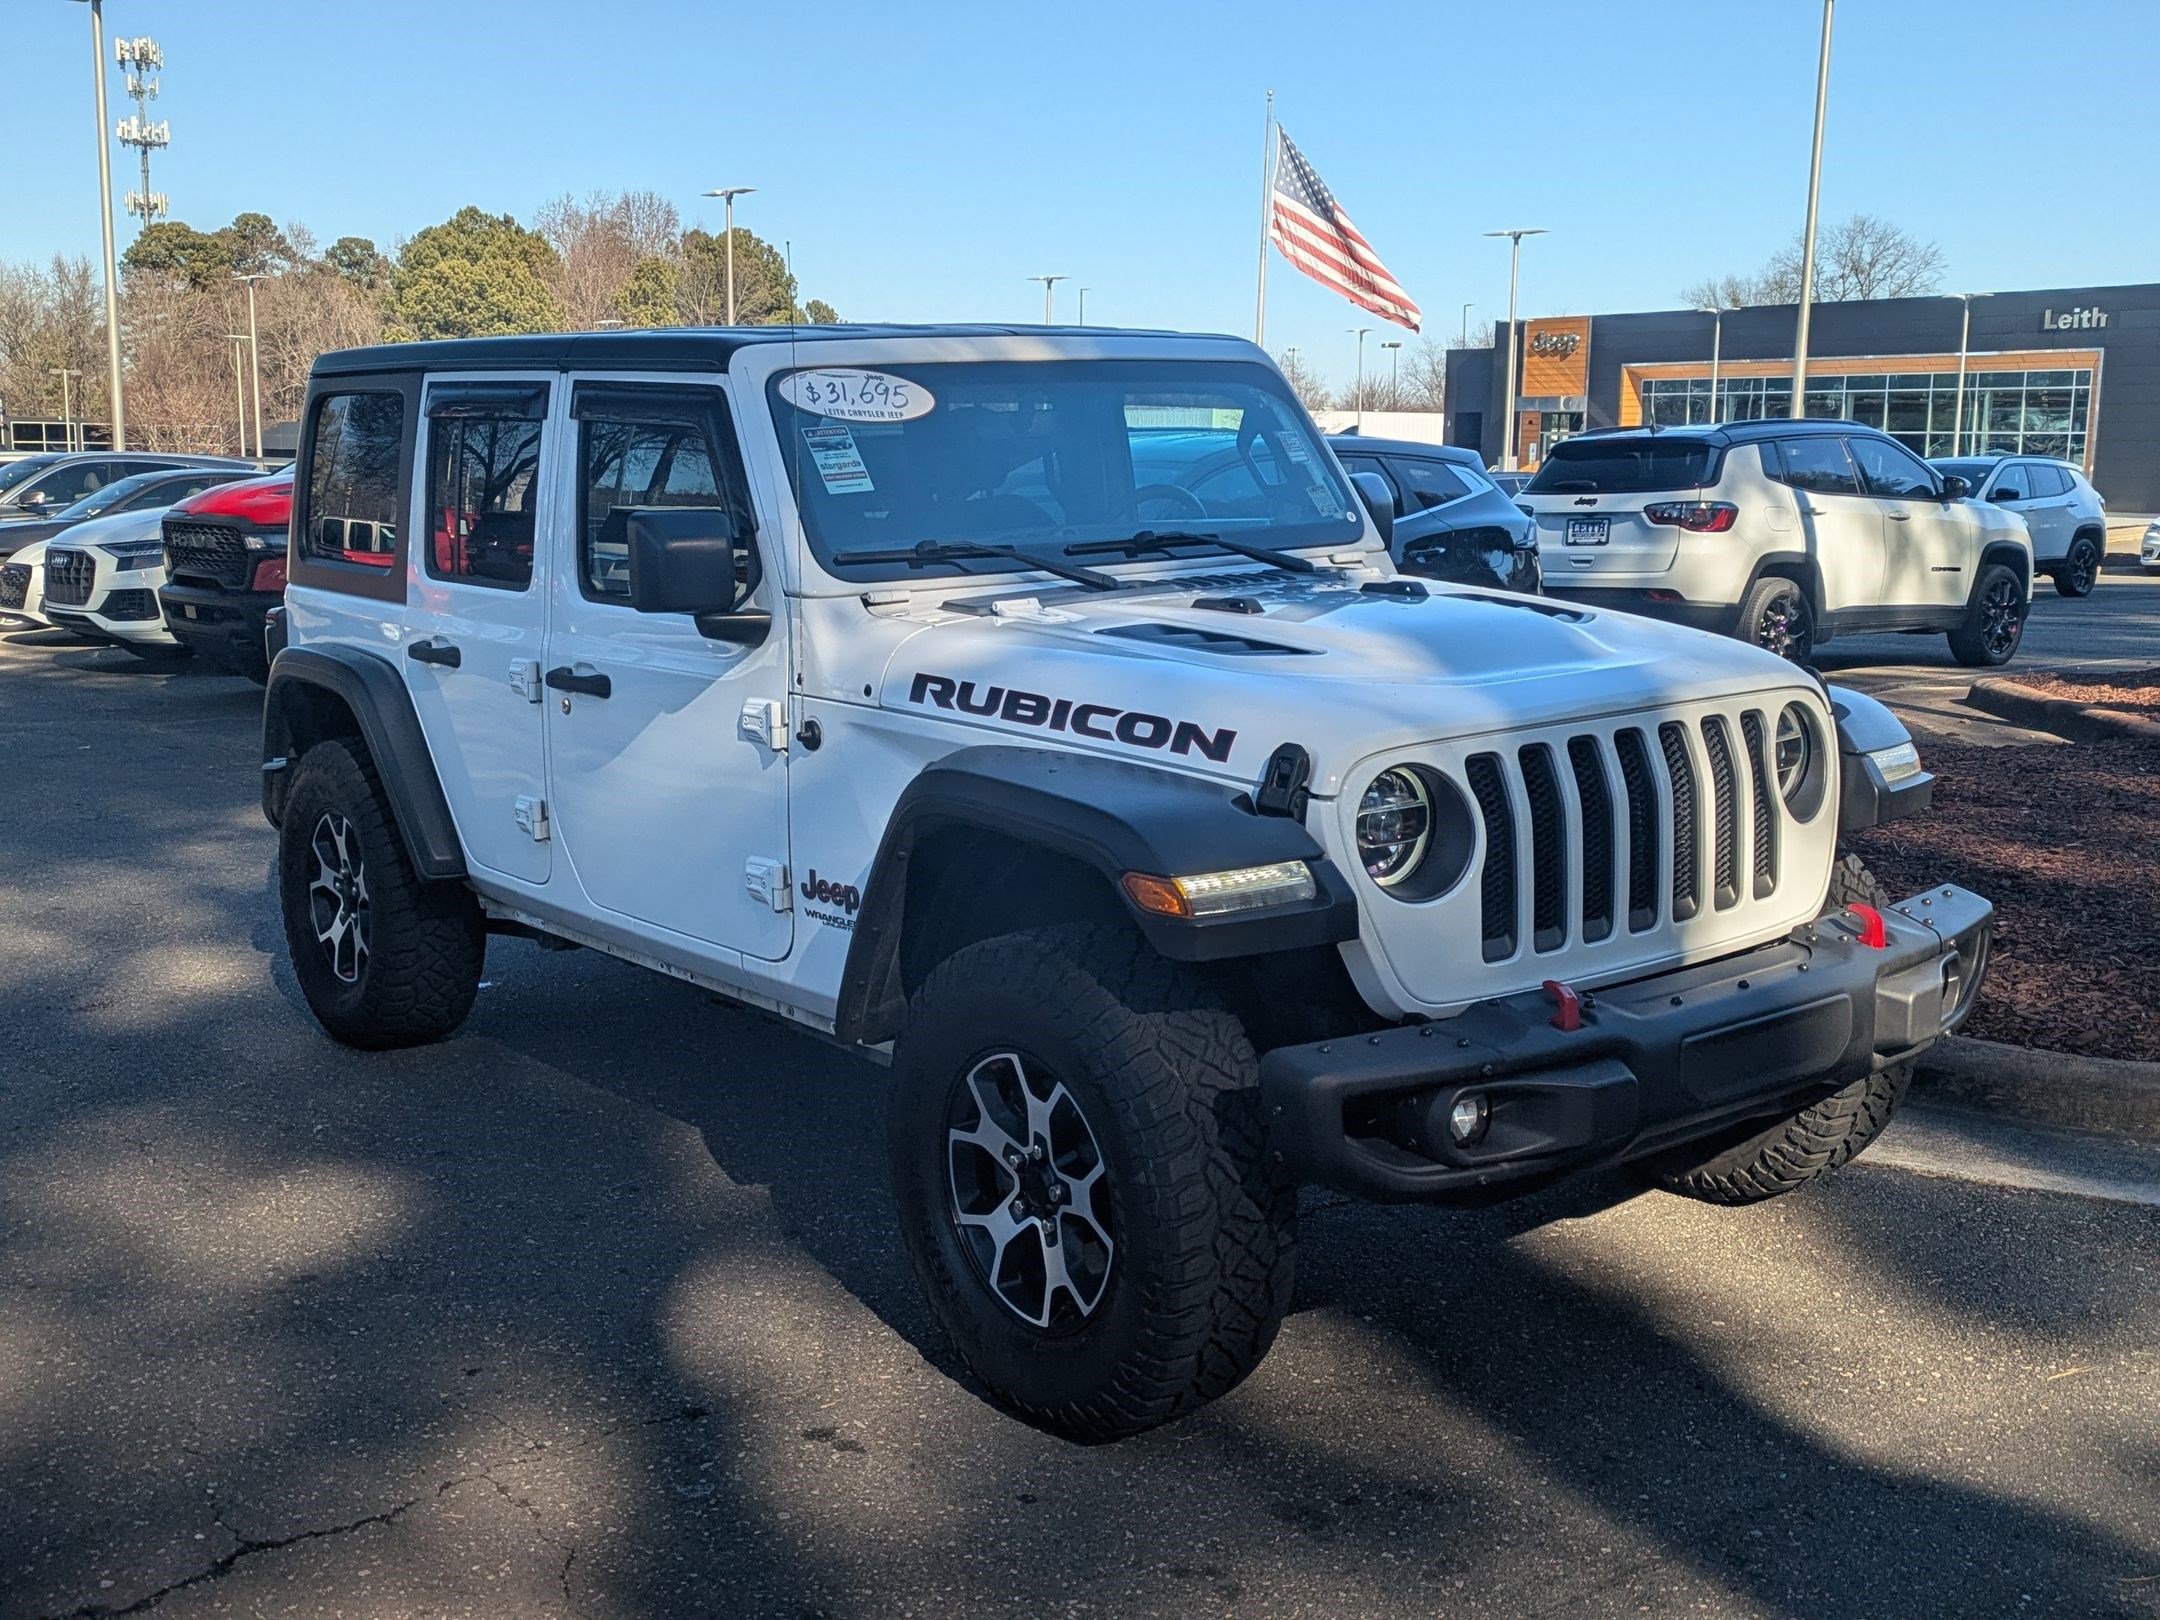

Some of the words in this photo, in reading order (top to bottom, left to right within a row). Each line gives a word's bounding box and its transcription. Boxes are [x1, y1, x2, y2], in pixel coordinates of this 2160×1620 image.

[2043, 306, 2108, 330] Leith
[1531, 330, 1581, 353] Jeep
[806, 376, 910, 409] $31,695
[823, 407, 846, 417] LEITH
[848, 408, 885, 418] CHRYSLER
[887, 410, 904, 420] JEEP
[816, 428, 848, 436] ATTENTION
[1571, 521, 1606, 533] LEITH
[908, 672, 1238, 763] RUBICON
[800, 868, 860, 916] Jeep
